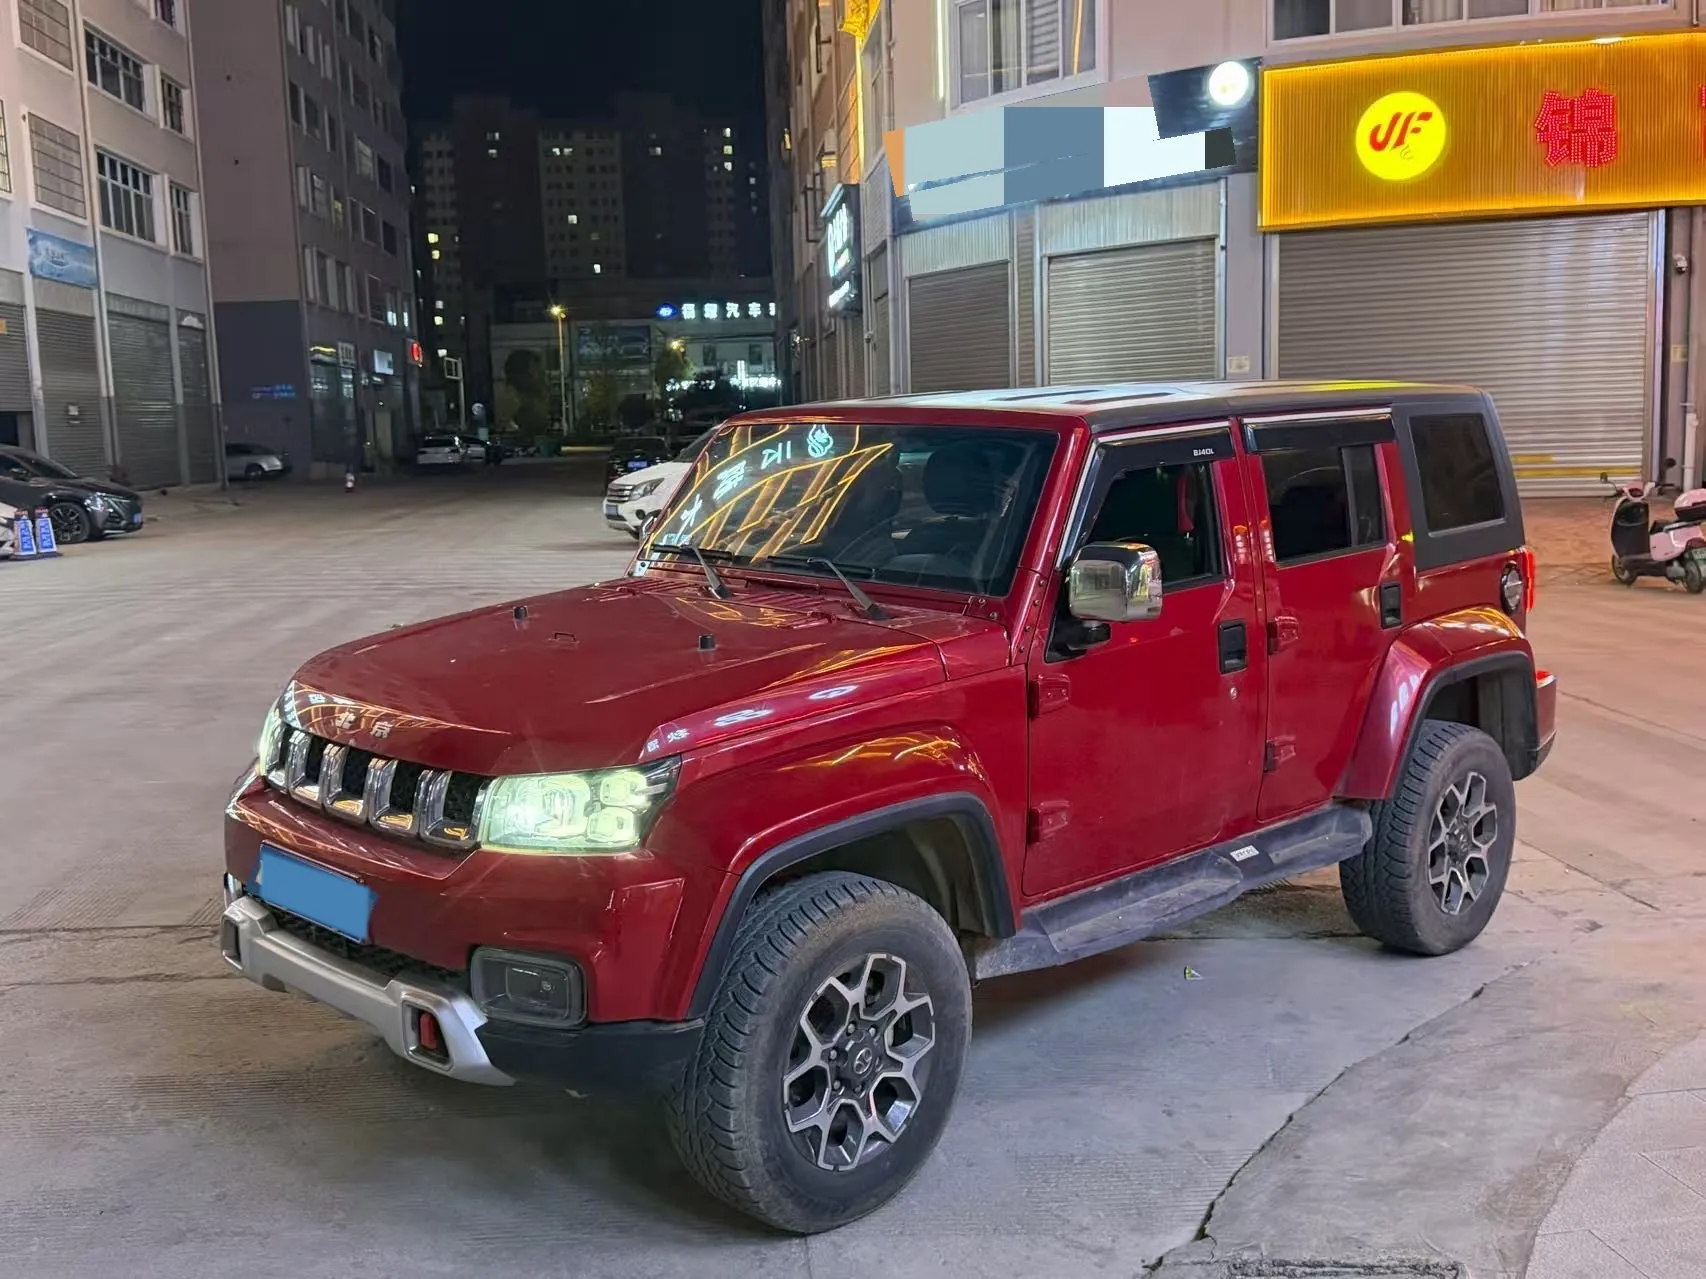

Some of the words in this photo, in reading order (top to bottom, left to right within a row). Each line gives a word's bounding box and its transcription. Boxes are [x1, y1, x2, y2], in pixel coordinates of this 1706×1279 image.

[1369, 111, 1433, 152] JF
[1534, 88, 1617, 168] 锦
[335, 711, 393, 738] 北京
